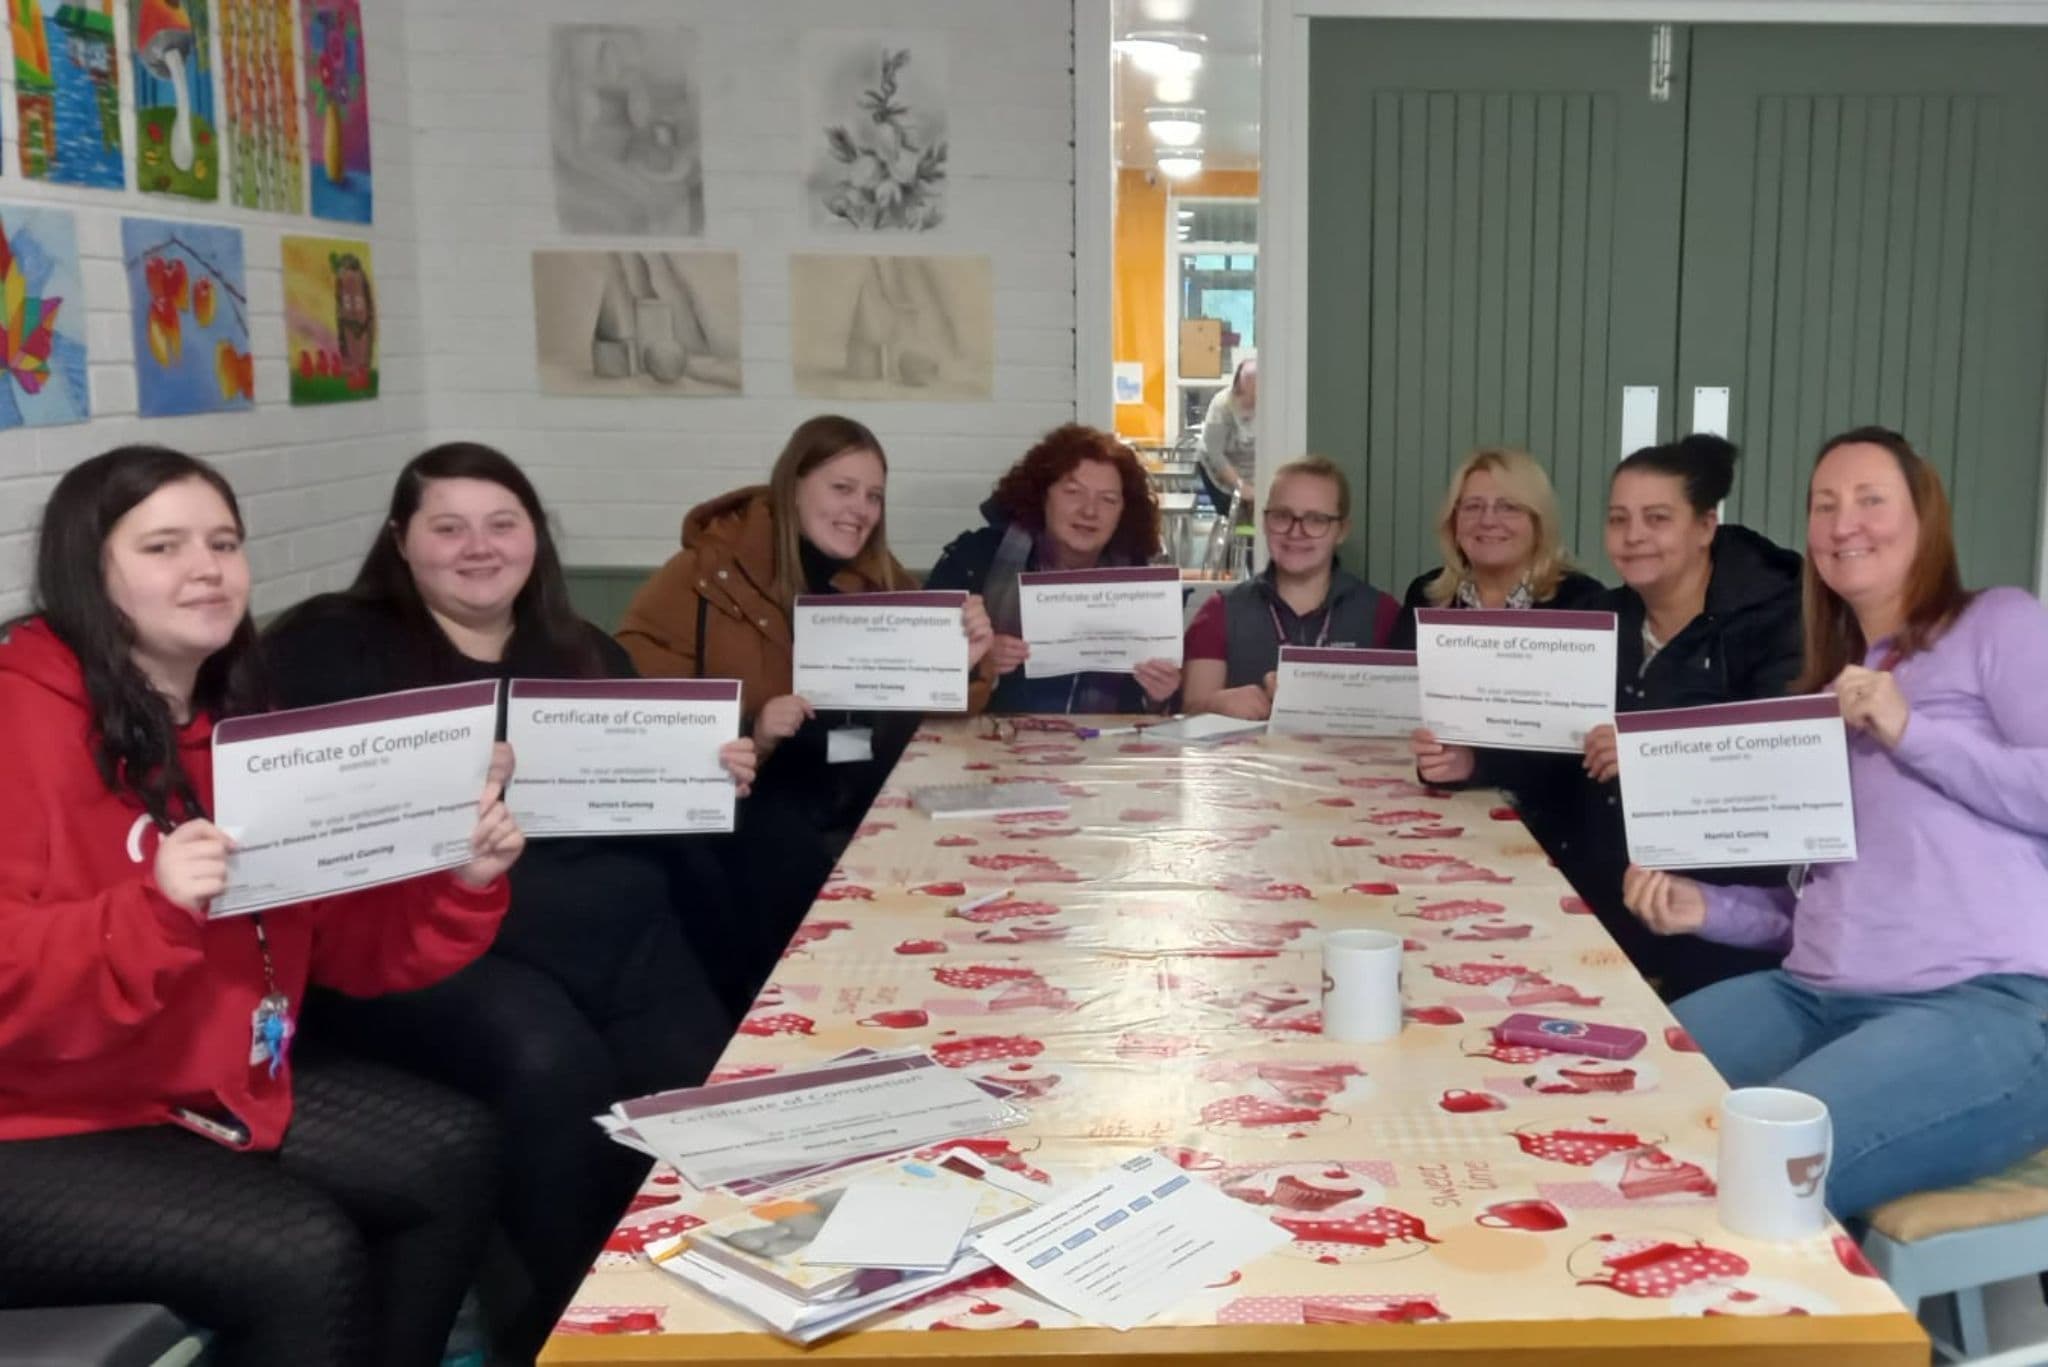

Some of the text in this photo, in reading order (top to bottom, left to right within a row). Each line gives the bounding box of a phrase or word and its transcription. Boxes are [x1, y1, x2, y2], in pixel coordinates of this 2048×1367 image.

[1037, 590, 1166, 603] Certificate of Completion
[812, 614, 951, 626] Certificate of Completion
[1436, 634, 1595, 654] Certificate of Completion
[1294, 670, 1345, 680] Certificate
[533, 710, 716, 726] Certificate of Completion
[247, 724, 470, 773] Certificate of Completion
[1640, 733, 1821, 757] Certificate of Completion
[318, 854, 354, 868] Harriet
[670, 1101, 777, 1124] Certificate
[783, 1094, 803, 1108] of
[808, 1074, 924, 1102] Completion
